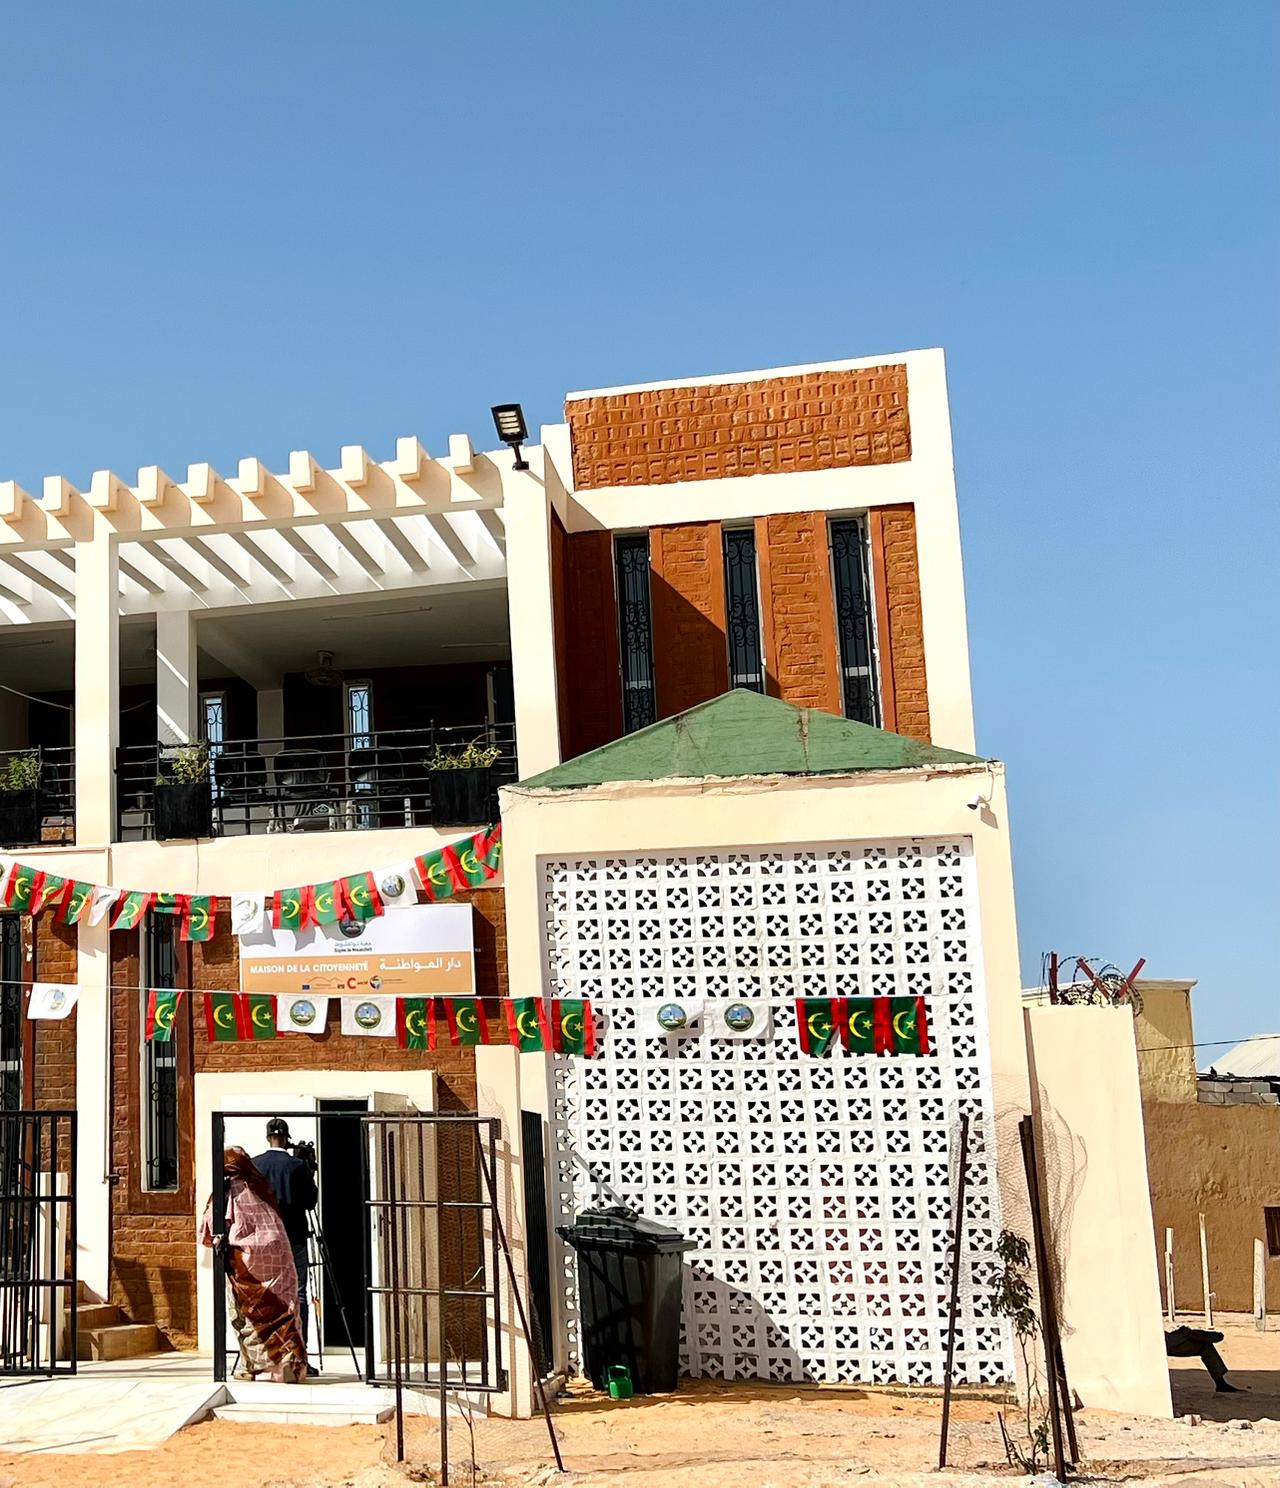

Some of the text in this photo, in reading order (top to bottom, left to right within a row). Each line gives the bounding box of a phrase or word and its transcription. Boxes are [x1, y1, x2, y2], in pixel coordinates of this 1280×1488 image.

[250, 960, 369, 974] MAISON DE LA CITOYENNETÉ
[445, 957, 461, 972] دار
